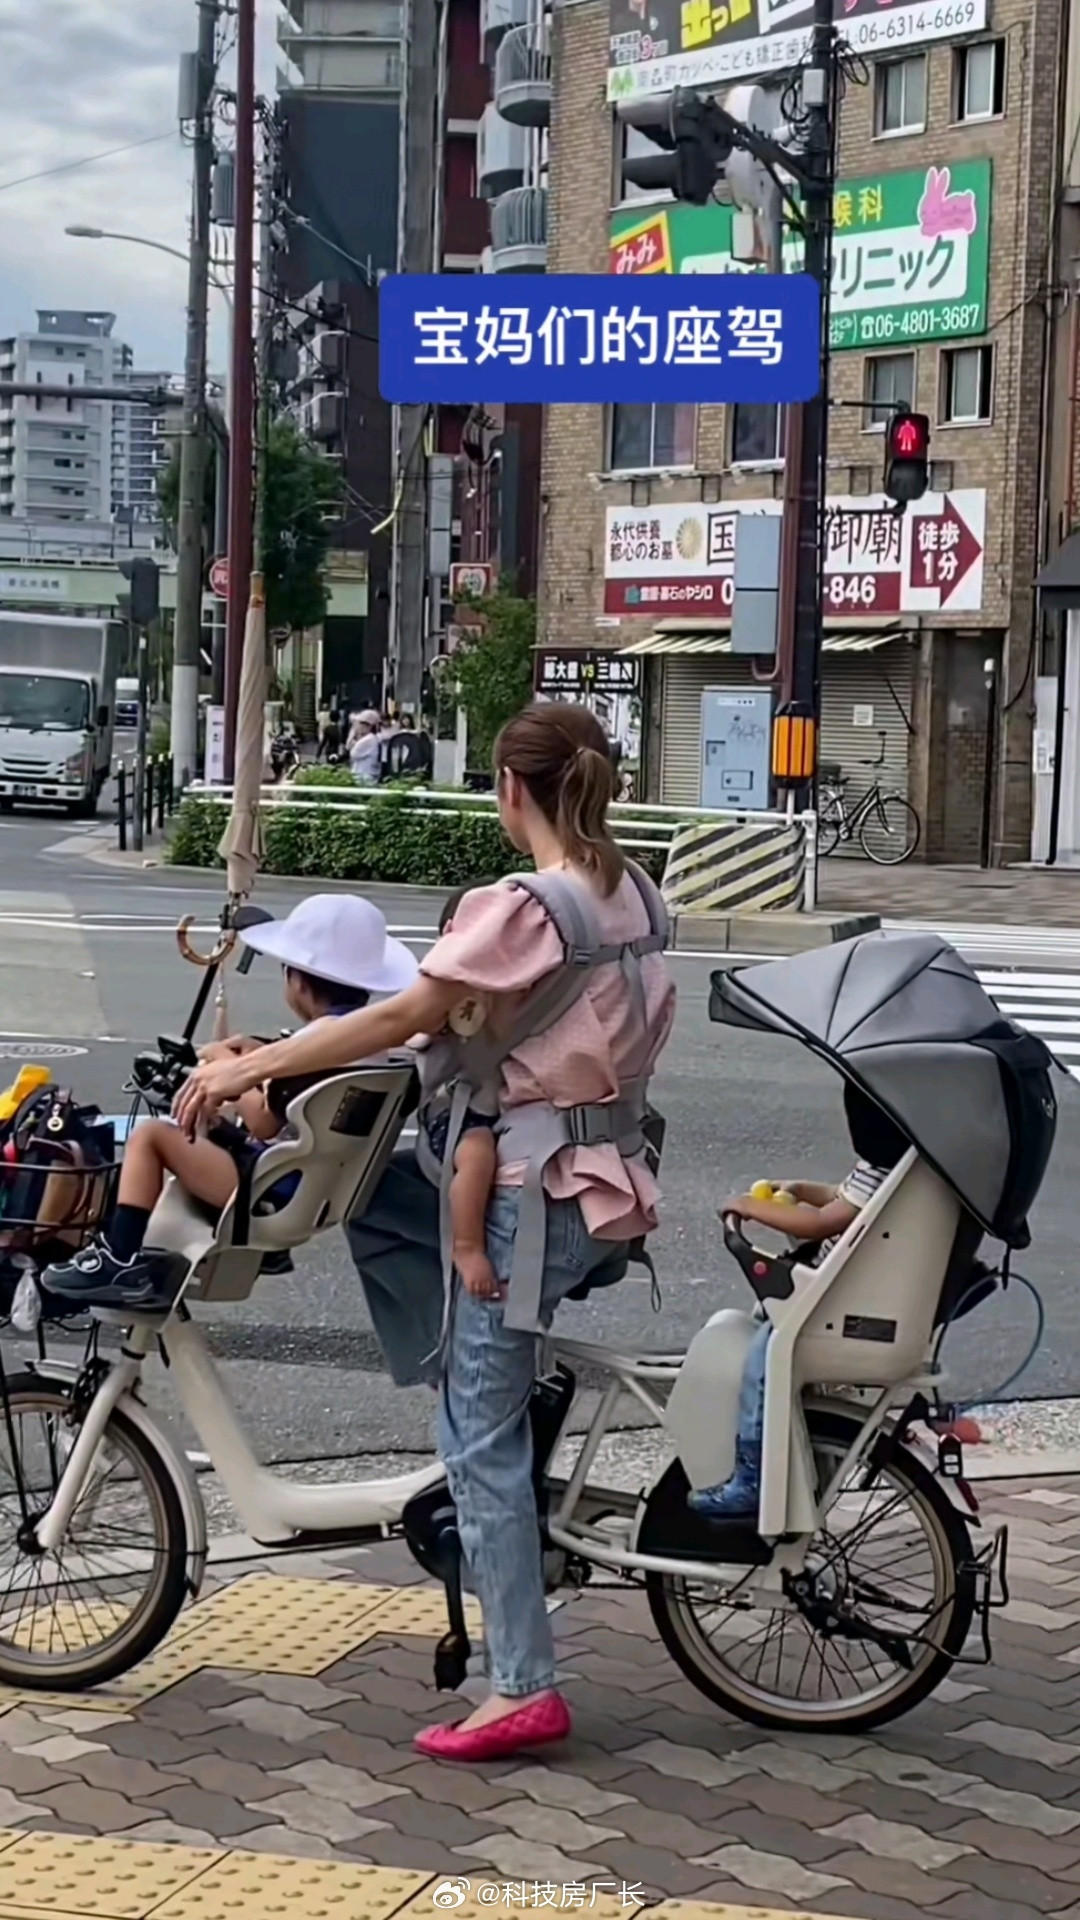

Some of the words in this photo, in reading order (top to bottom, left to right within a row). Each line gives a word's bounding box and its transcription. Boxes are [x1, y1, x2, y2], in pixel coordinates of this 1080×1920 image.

[838, 2, 975, 49] L:06-6314-6669
[615, 233, 657, 274] みみ
[831, 234, 956, 299] リニック
[875, 303, 980, 339] 06-4801-3687
[610, 520, 661, 541] 永代供養
[918, 520, 960, 551] 徒歩
[922, 551, 959, 584] 1分
